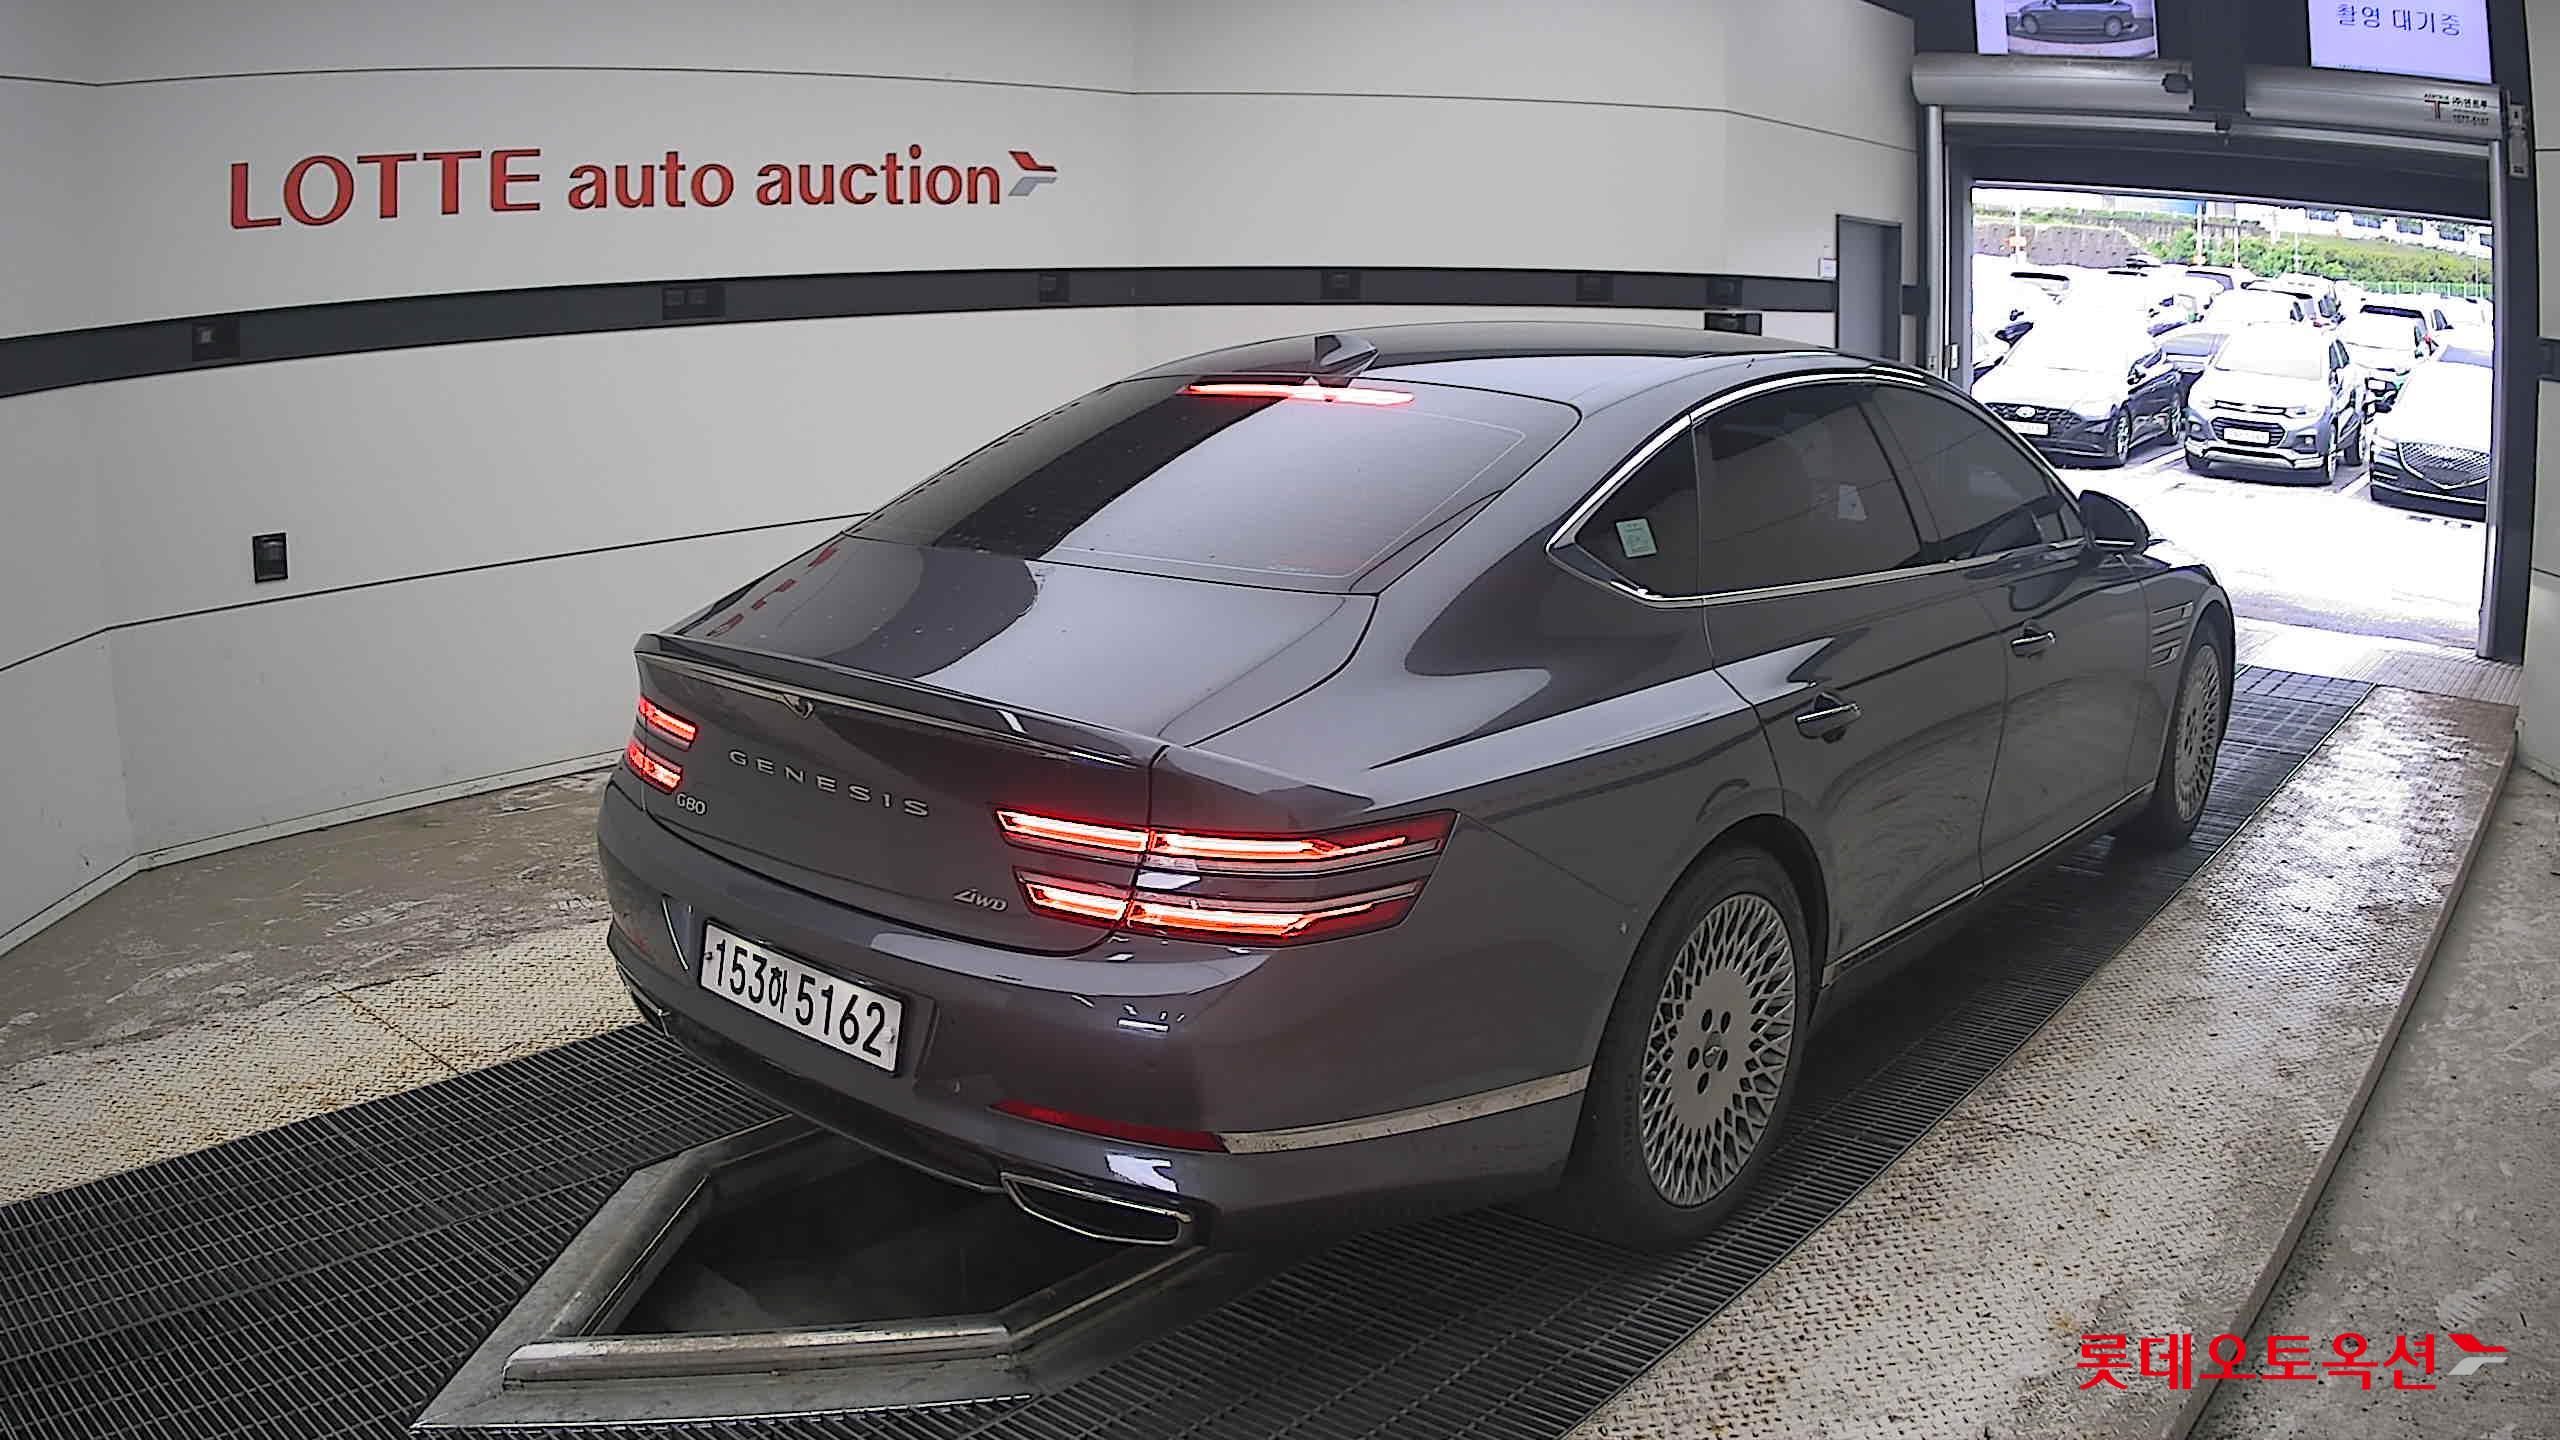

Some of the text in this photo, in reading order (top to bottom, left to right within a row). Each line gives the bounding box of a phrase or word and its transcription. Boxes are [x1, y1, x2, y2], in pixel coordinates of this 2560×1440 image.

[2337, 4, 2461, 36] 촬영 대기중
[230, 144, 1001, 230] LOTTE auto auction
[676, 793, 708, 816] G80
[729, 750, 930, 818] GENESIS
[716, 939, 885, 1058] 153하 5162
